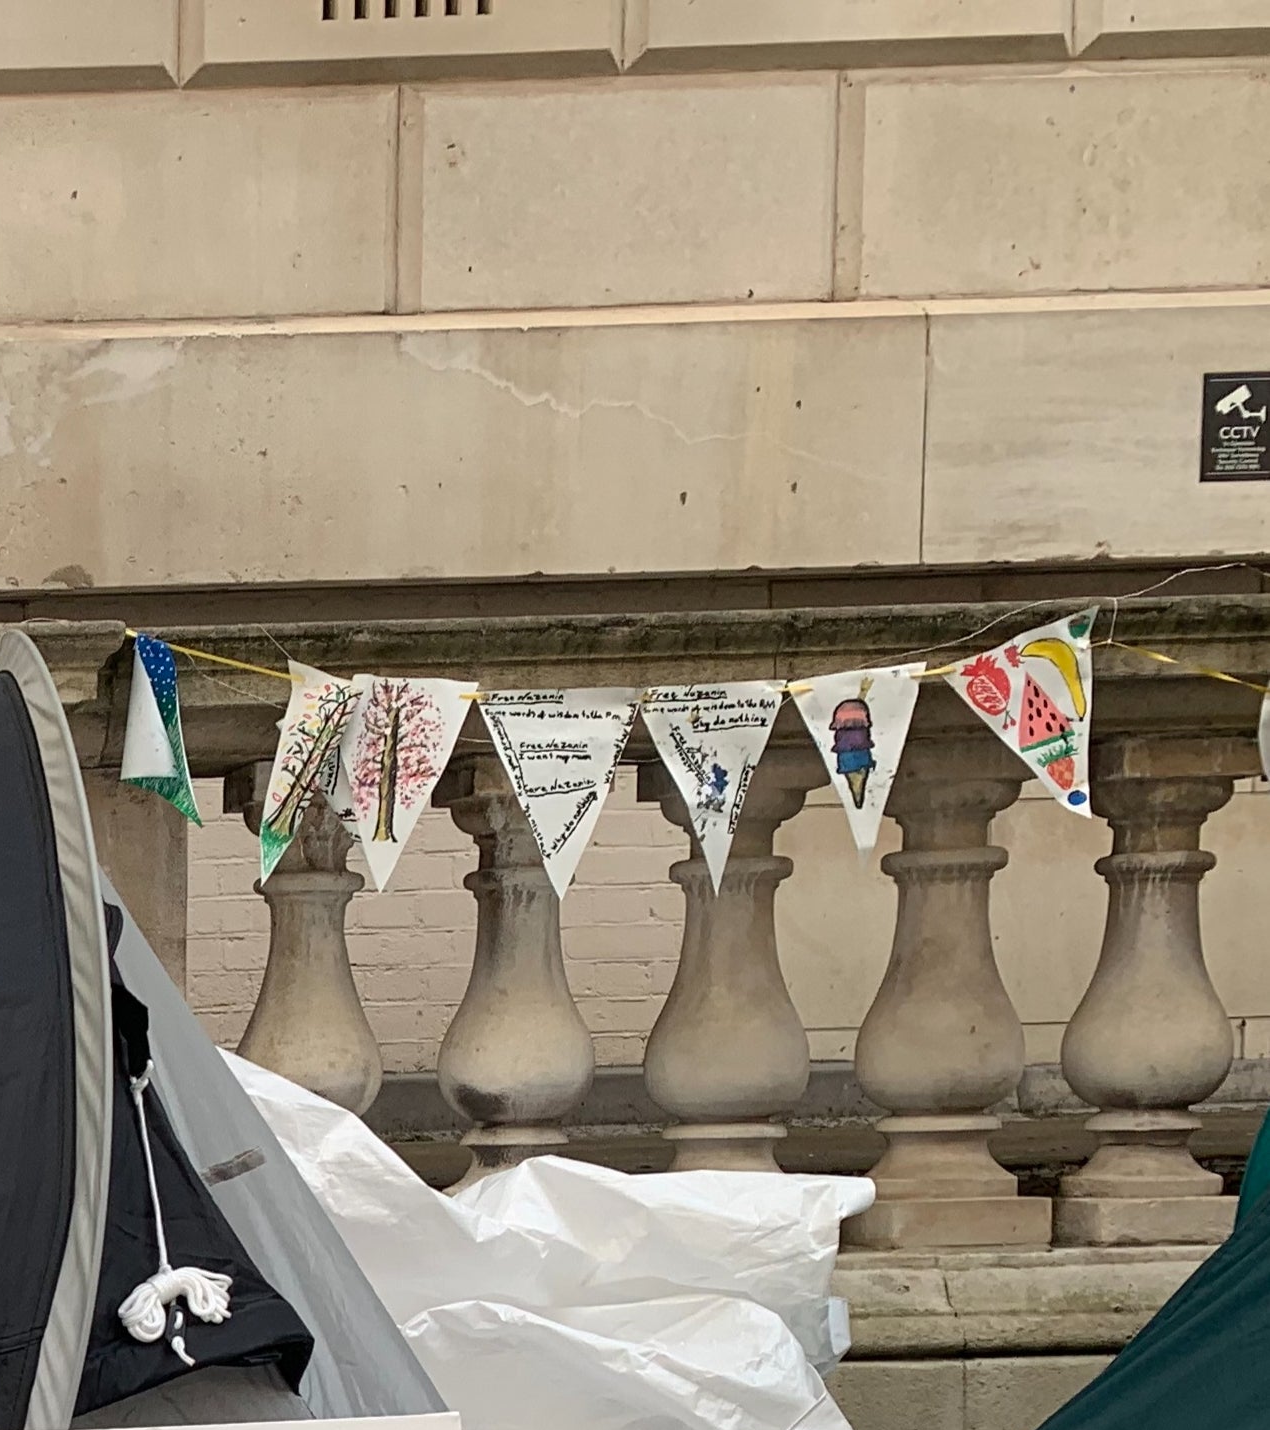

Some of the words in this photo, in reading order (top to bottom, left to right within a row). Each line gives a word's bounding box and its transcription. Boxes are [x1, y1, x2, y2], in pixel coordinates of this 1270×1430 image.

[1219, 426, 1260, 439] CCTV
[517, 692, 564, 702] Nazanin
[520, 741, 544, 749] Free
[545, 738, 588, 750] Nazanin
